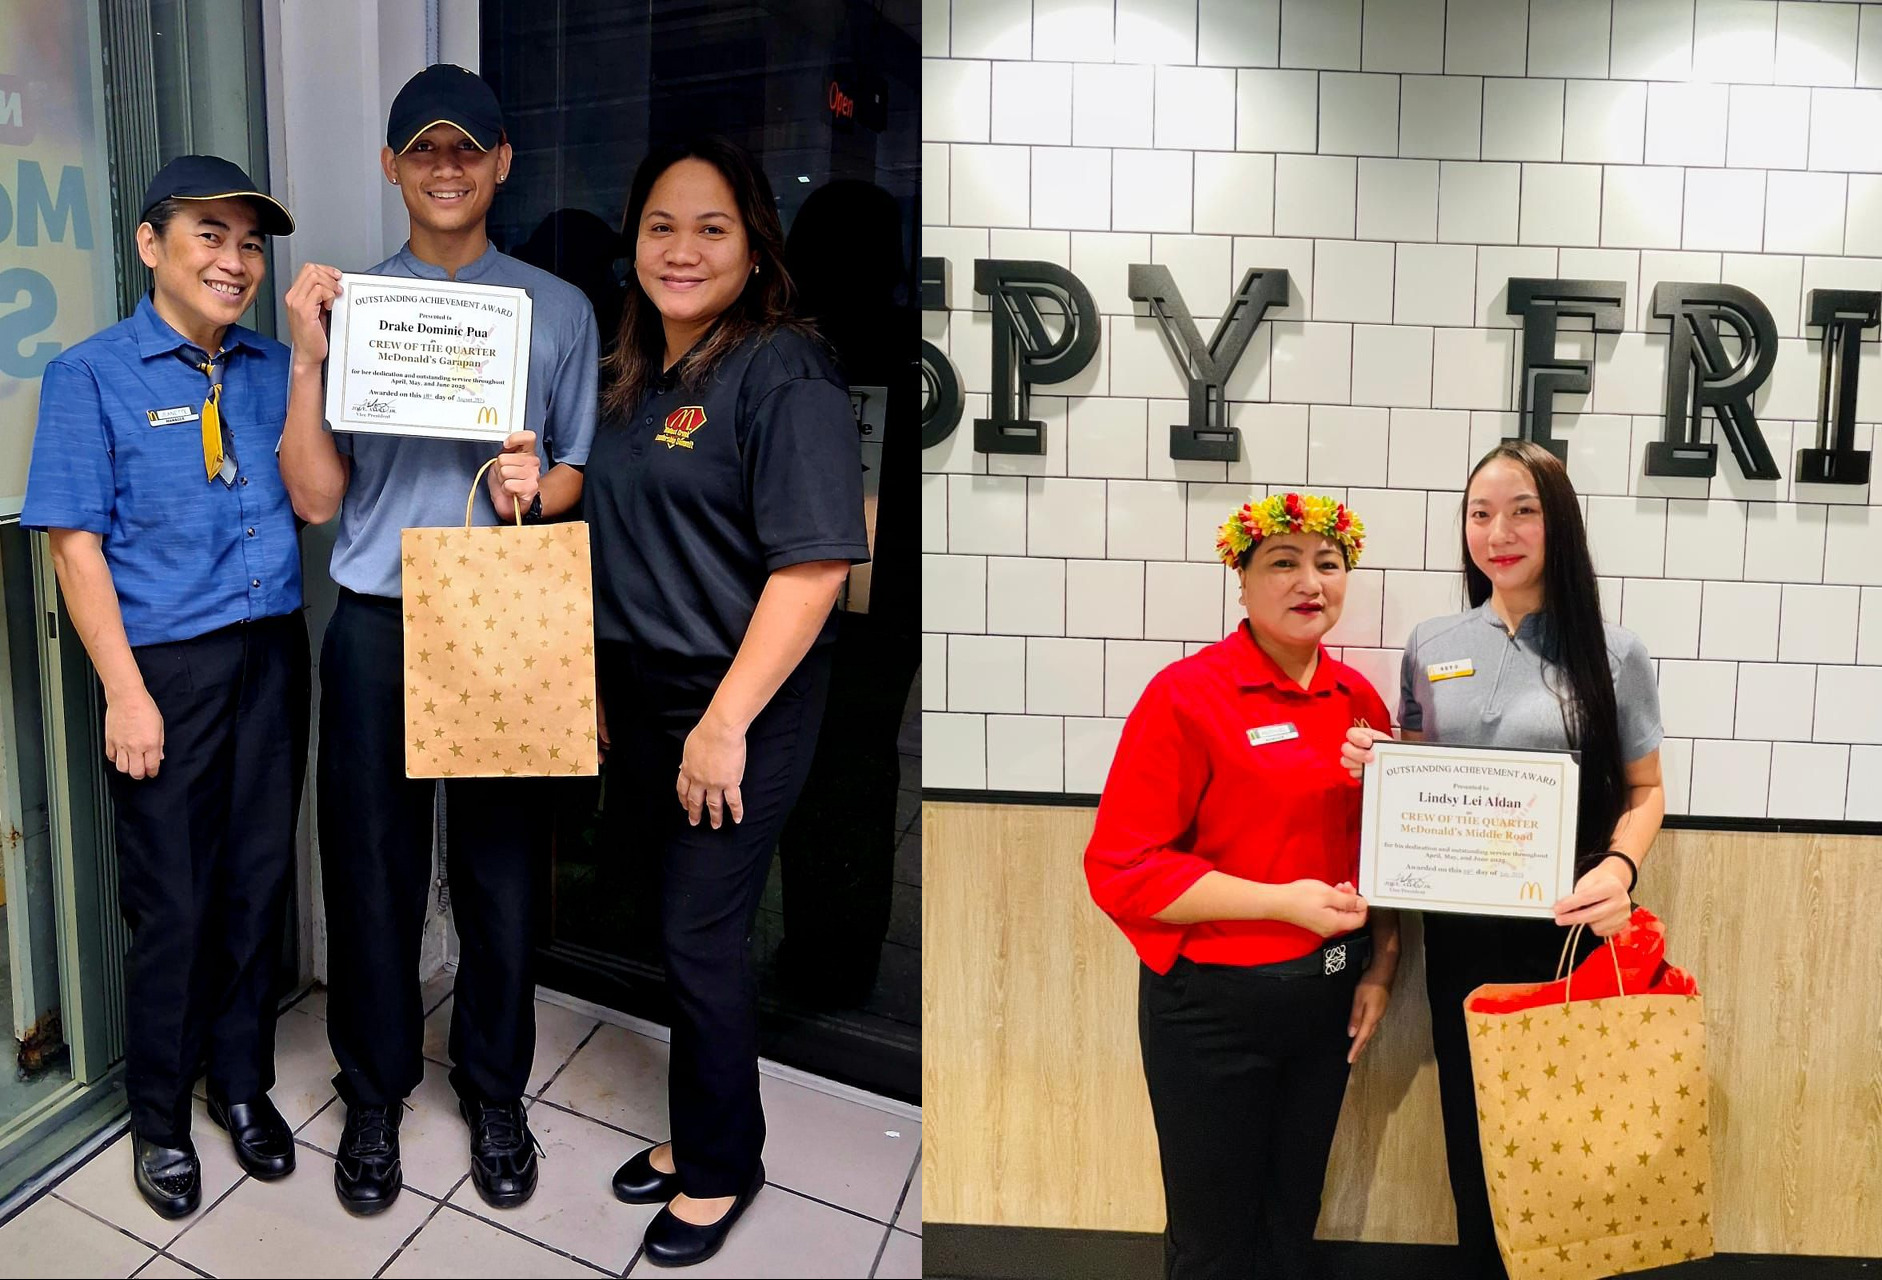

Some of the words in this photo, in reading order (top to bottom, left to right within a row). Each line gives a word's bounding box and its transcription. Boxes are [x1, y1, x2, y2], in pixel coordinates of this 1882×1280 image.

[830, 81, 853, 118] Open
[355, 295, 418, 306] OUTSTANDING
[419, 296, 480, 309] ACHIEVEMENT
[481, 303, 513, 318] AWARD
[379, 320, 414, 332] Drake
[417, 323, 464, 336] Dominic
[467, 326, 488, 338] Pua
[368, 340, 402, 350] CREW
[404, 342, 419, 351] OF
[420, 344, 443, 353] THE
[445, 346, 497, 357] QUARTER
[378, 352, 437, 364] McDonald's
[439, 356, 481, 368] Garapan
[368, 389, 399, 397] Awarded
[1386, 765, 1452, 776] OUTSTANDING
[1452, 766, 1520, 778] ACHIEVEMENT
[1520, 772, 1557, 786] AWARD
[1419, 792, 1459, 807] Lindsy
[1463, 794, 1482, 806] Lei
[1485, 796, 1522, 808] Aldan
[1401, 812, 1435, 822] CREW
[1438, 815, 1454, 823] OF
[1455, 816, 1480, 825] THE
[1482, 818, 1539, 830] QUARTER
[1466, 828, 1502, 839] Middle
[1506, 830, 1534, 840] Road
[1405, 864, 1437, 872] Awarded
